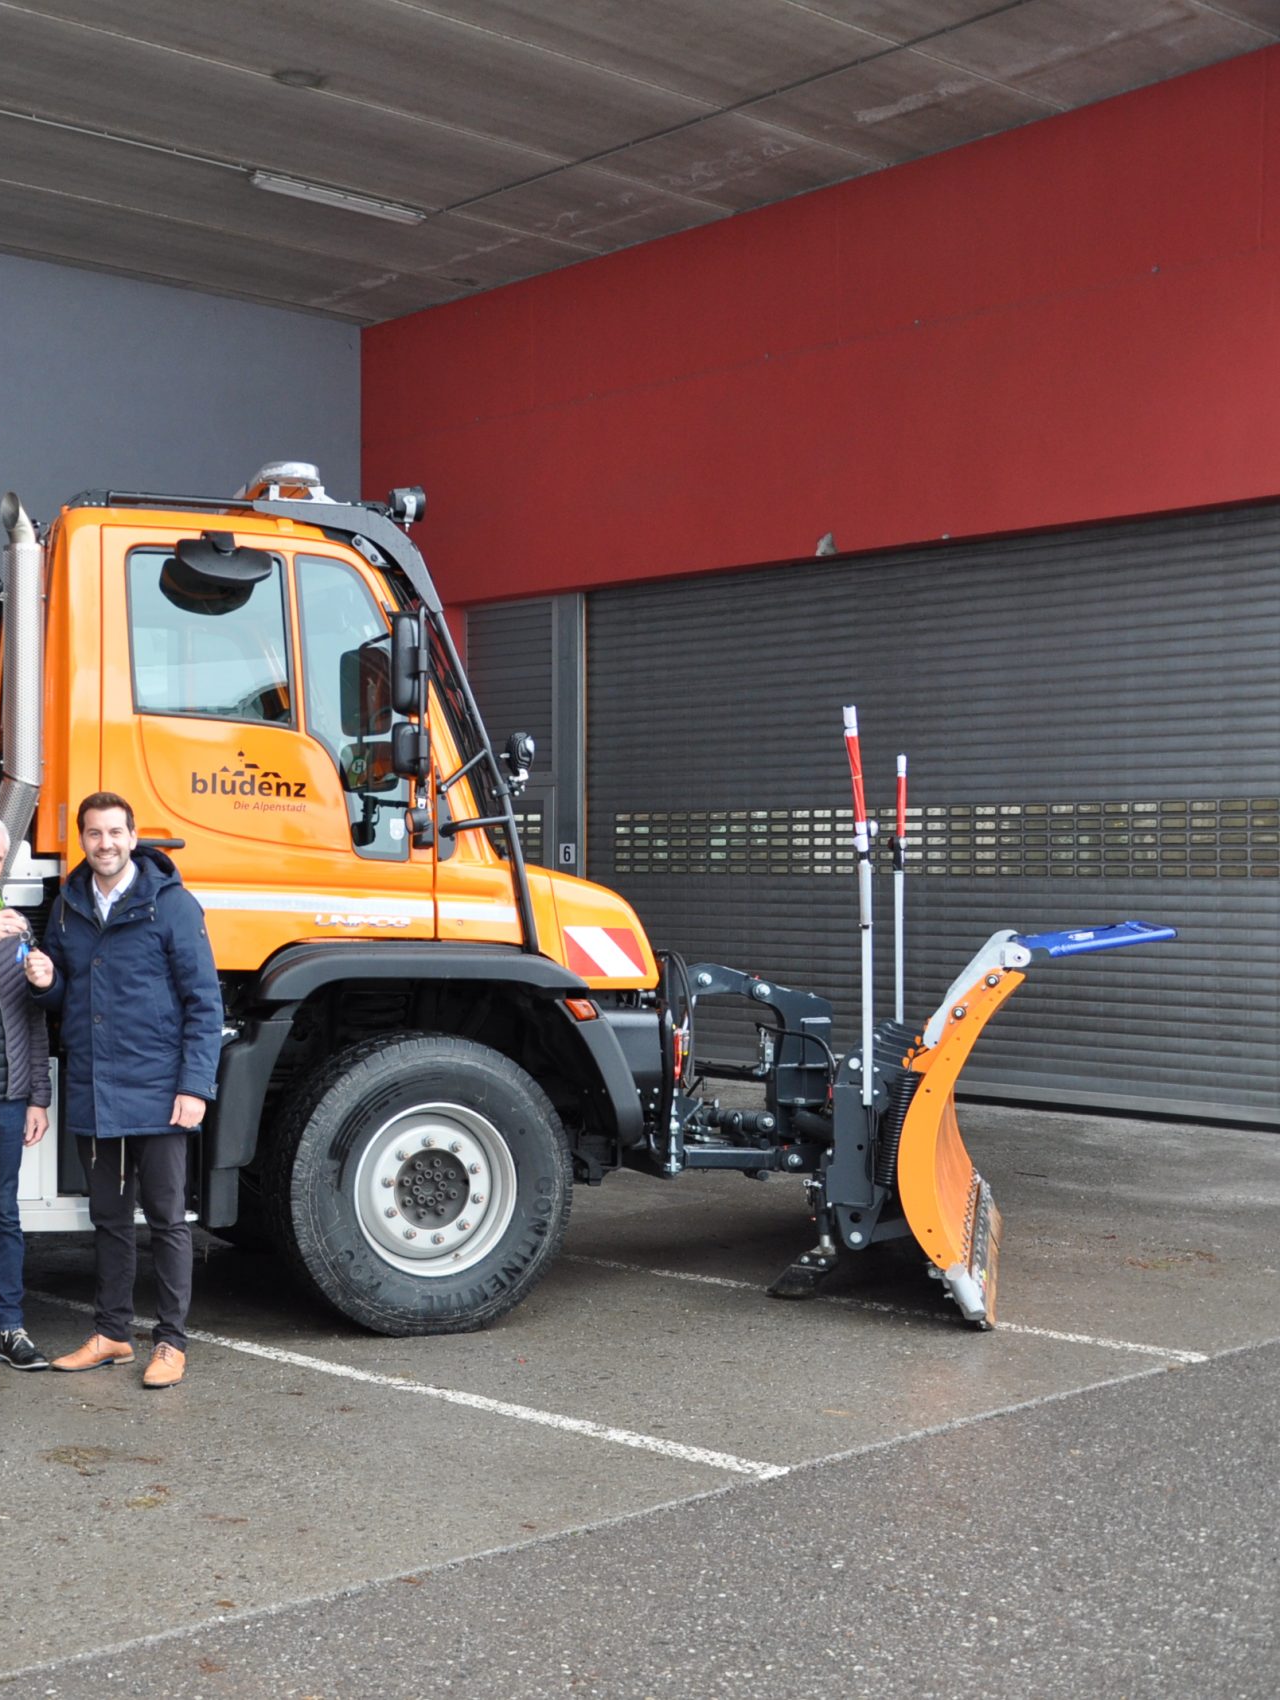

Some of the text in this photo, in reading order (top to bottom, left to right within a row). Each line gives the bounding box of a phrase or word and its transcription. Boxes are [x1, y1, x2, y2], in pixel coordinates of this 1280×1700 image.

[191, 772, 306, 798] bludenz
[233, 800, 307, 813] Die Alpenstadt
[563, 845, 571, 862] 6
[420, 1176, 553, 1312] CONTINENTAL
